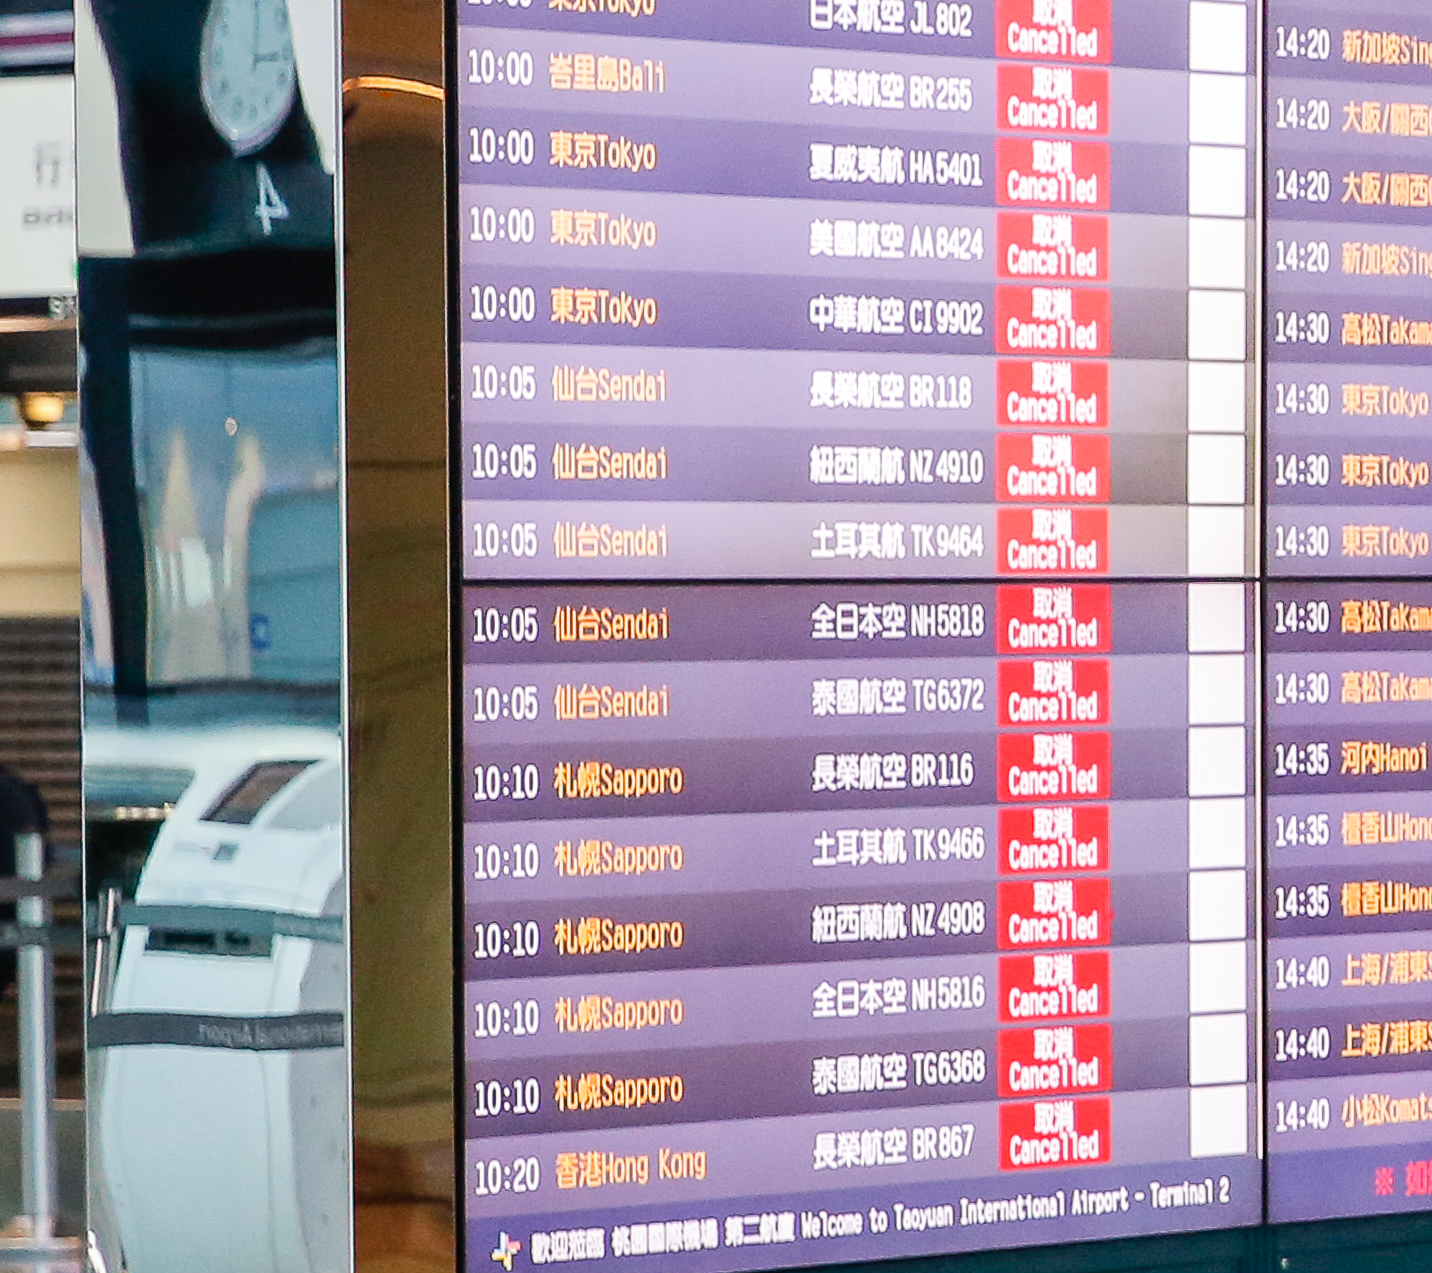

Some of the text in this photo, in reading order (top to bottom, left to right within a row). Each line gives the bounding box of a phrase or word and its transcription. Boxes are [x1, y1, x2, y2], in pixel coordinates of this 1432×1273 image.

[1008, 20, 1098, 57] Cancelled
[471, 286, 534, 321] 10:00
[550, 286, 656, 327] 東京Tokyo
[810, 294, 903, 333] 中華航空
[1033, 285, 1072, 319] 取消
[1008, 316, 1098, 349] Cancelled
[1275, 311, 1329, 343] 14:30
[1033, 587, 1072, 619] 取消
[473, 607, 537, 641] 10:05
[553, 605, 670, 641] 仙台Sendai
[812, 602, 906, 639] 全日本空
[1008, 618, 1098, 649] Cancelled
[1276, 956, 1329, 989] 14:40
[1033, 1101, 1073, 1137] 取消
[475, 1157, 539, 1195] 10:20
[556, 1148, 648, 1190] 香港Hong
[659, 1145, 707, 1182] Kong
[814, 1127, 906, 1169] 長榮航空
[1009, 1131, 1098, 1166] Cancelled
[801, 1208, 862, 1240] Welcome
[869, 1208, 887, 1234] to
[893, 1202, 953, 1236] Taoyuan
[959, 1190, 1065, 1227] International
[1071, 1185, 1128, 1219] Airport
[1149, 1177, 1213, 1210] Terminal
[1219, 1177, 1230, 1204] 2
